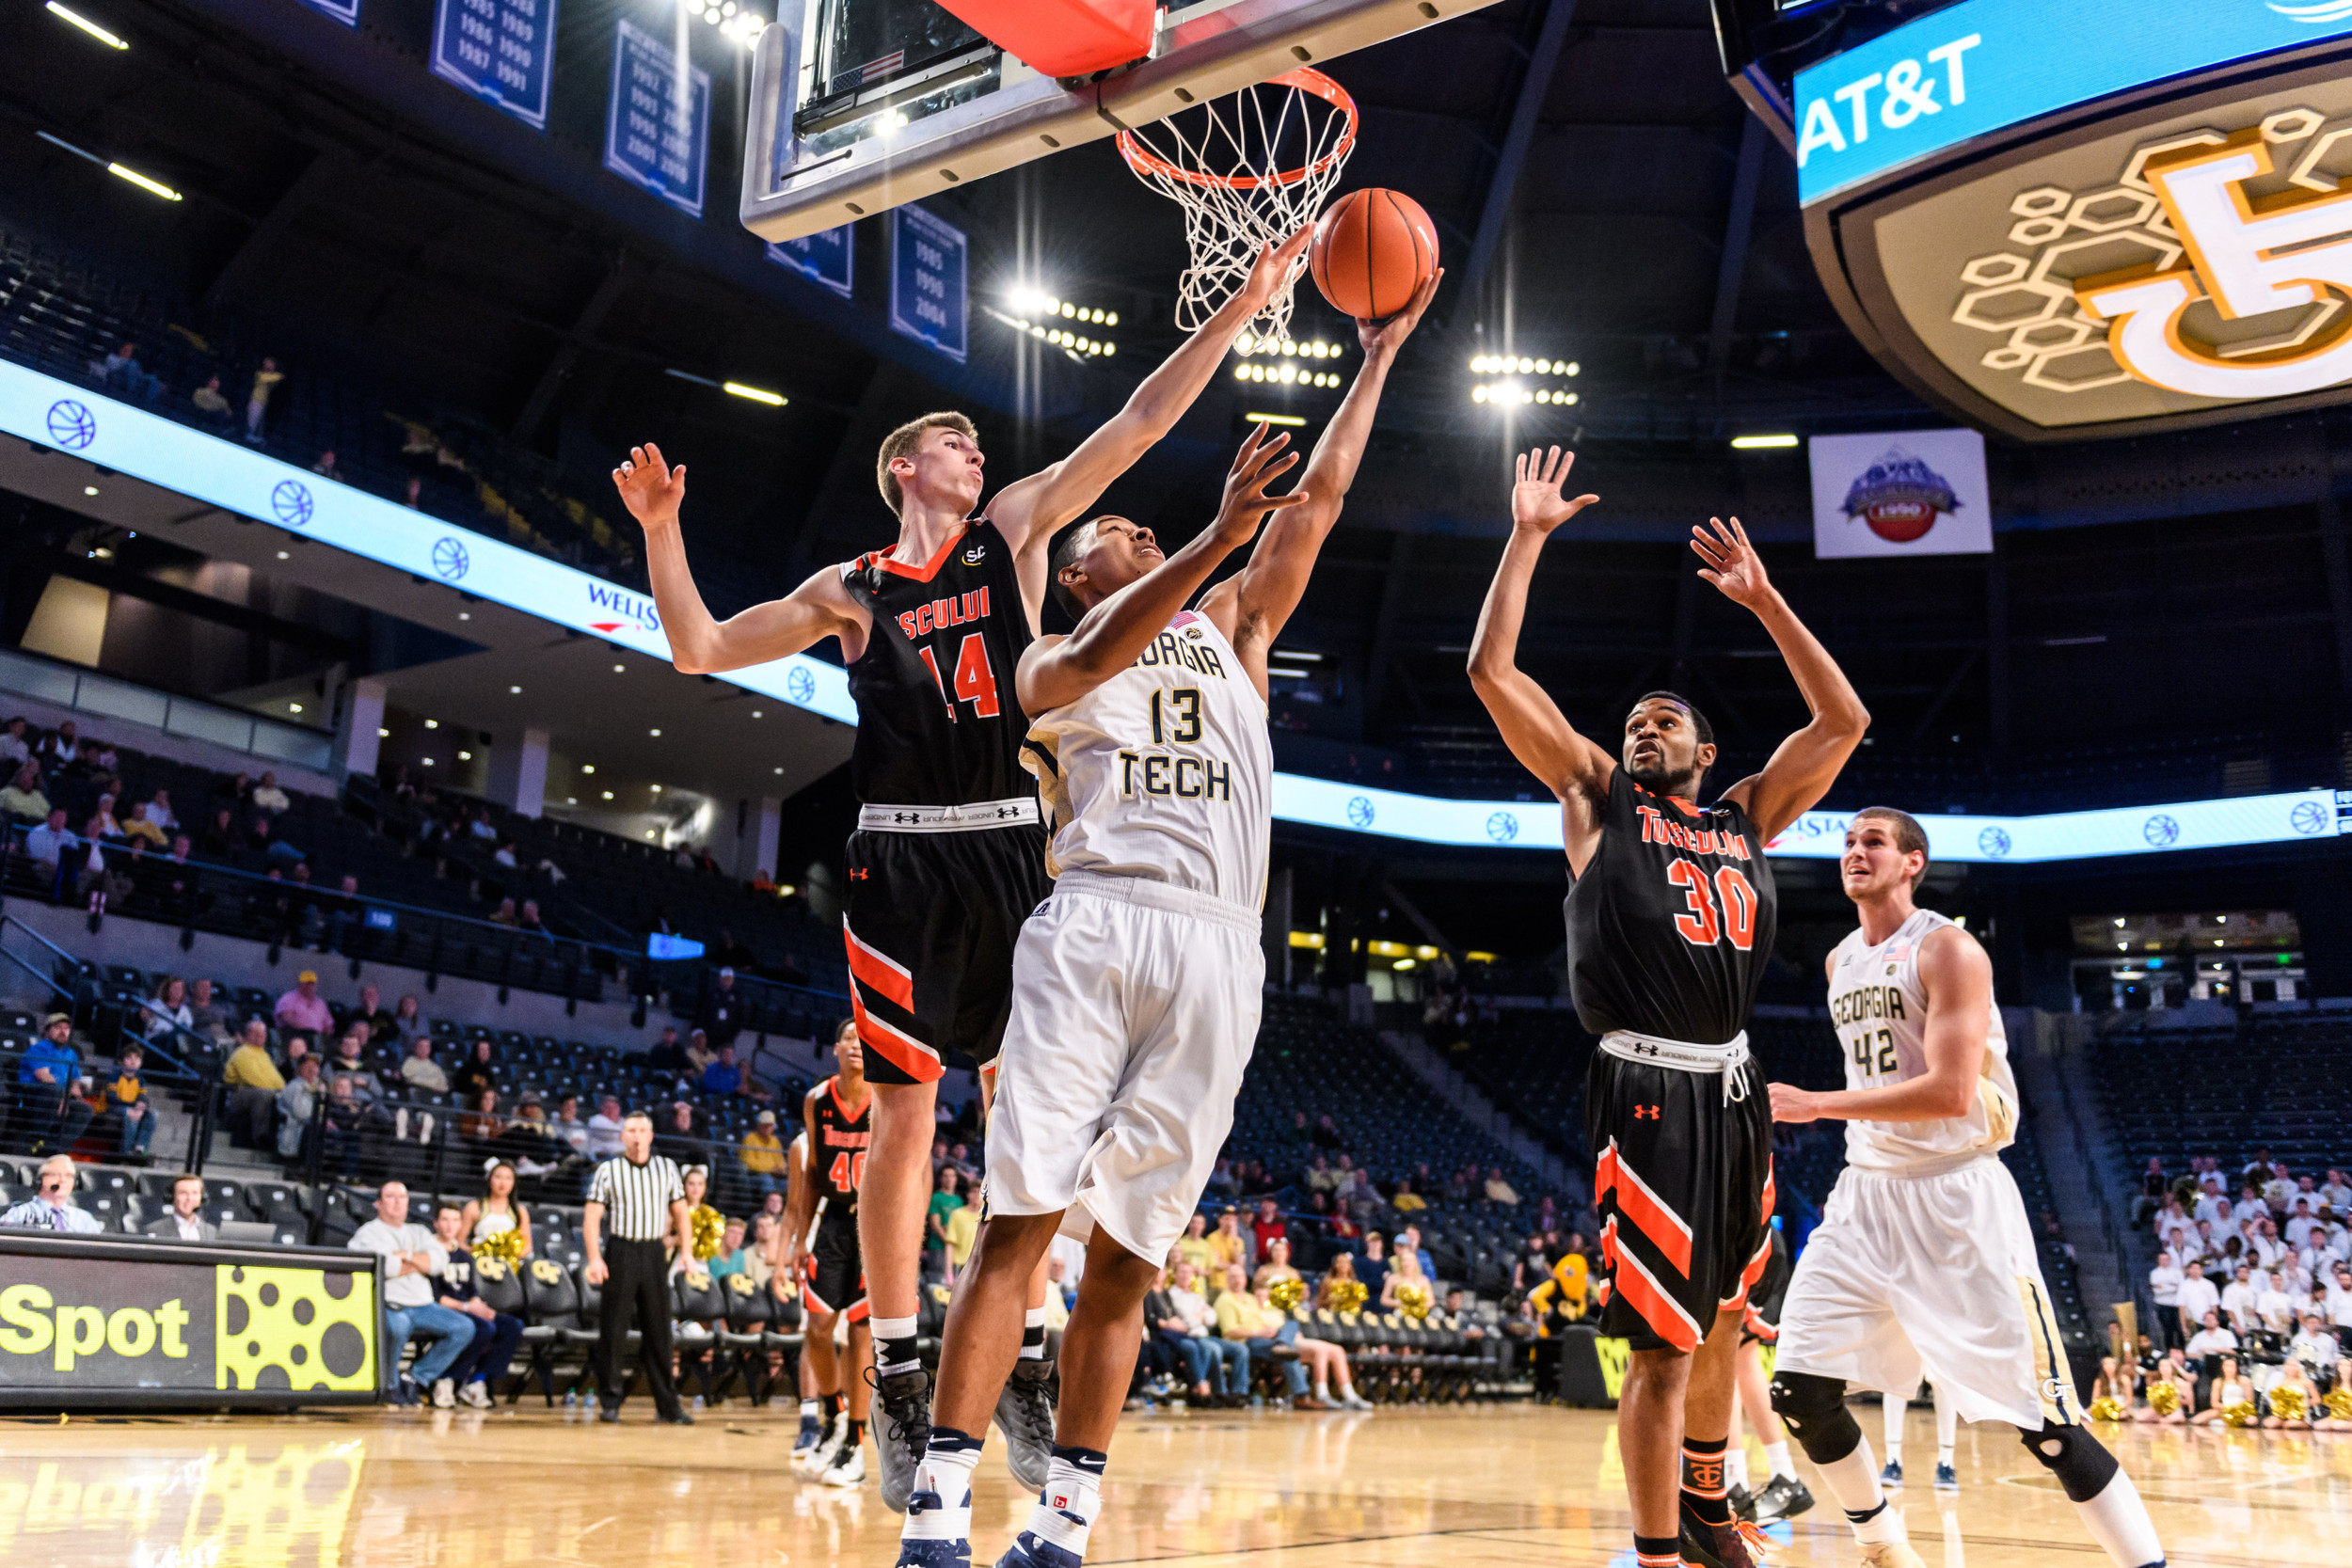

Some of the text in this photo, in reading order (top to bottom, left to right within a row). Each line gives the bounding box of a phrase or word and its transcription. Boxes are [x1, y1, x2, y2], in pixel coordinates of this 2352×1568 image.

[1798, 33, 1980, 167] AT&T
[589, 582, 659, 631] WELLS
[895, 586, 991, 640] SCULU
[1128, 632, 1228, 680] ORGIA
[1149, 687, 1203, 745] 13
[1119, 750, 1232, 803] TECH
[1667, 857, 1757, 951] 30
[1834, 986, 1906, 1030] GEORGIA
[1853, 1028, 1899, 1078] 42
[829, 1151, 866, 1193] 40
[0, 1284, 189, 1371] Spot
[2042, 1377, 2073, 1402] GT
